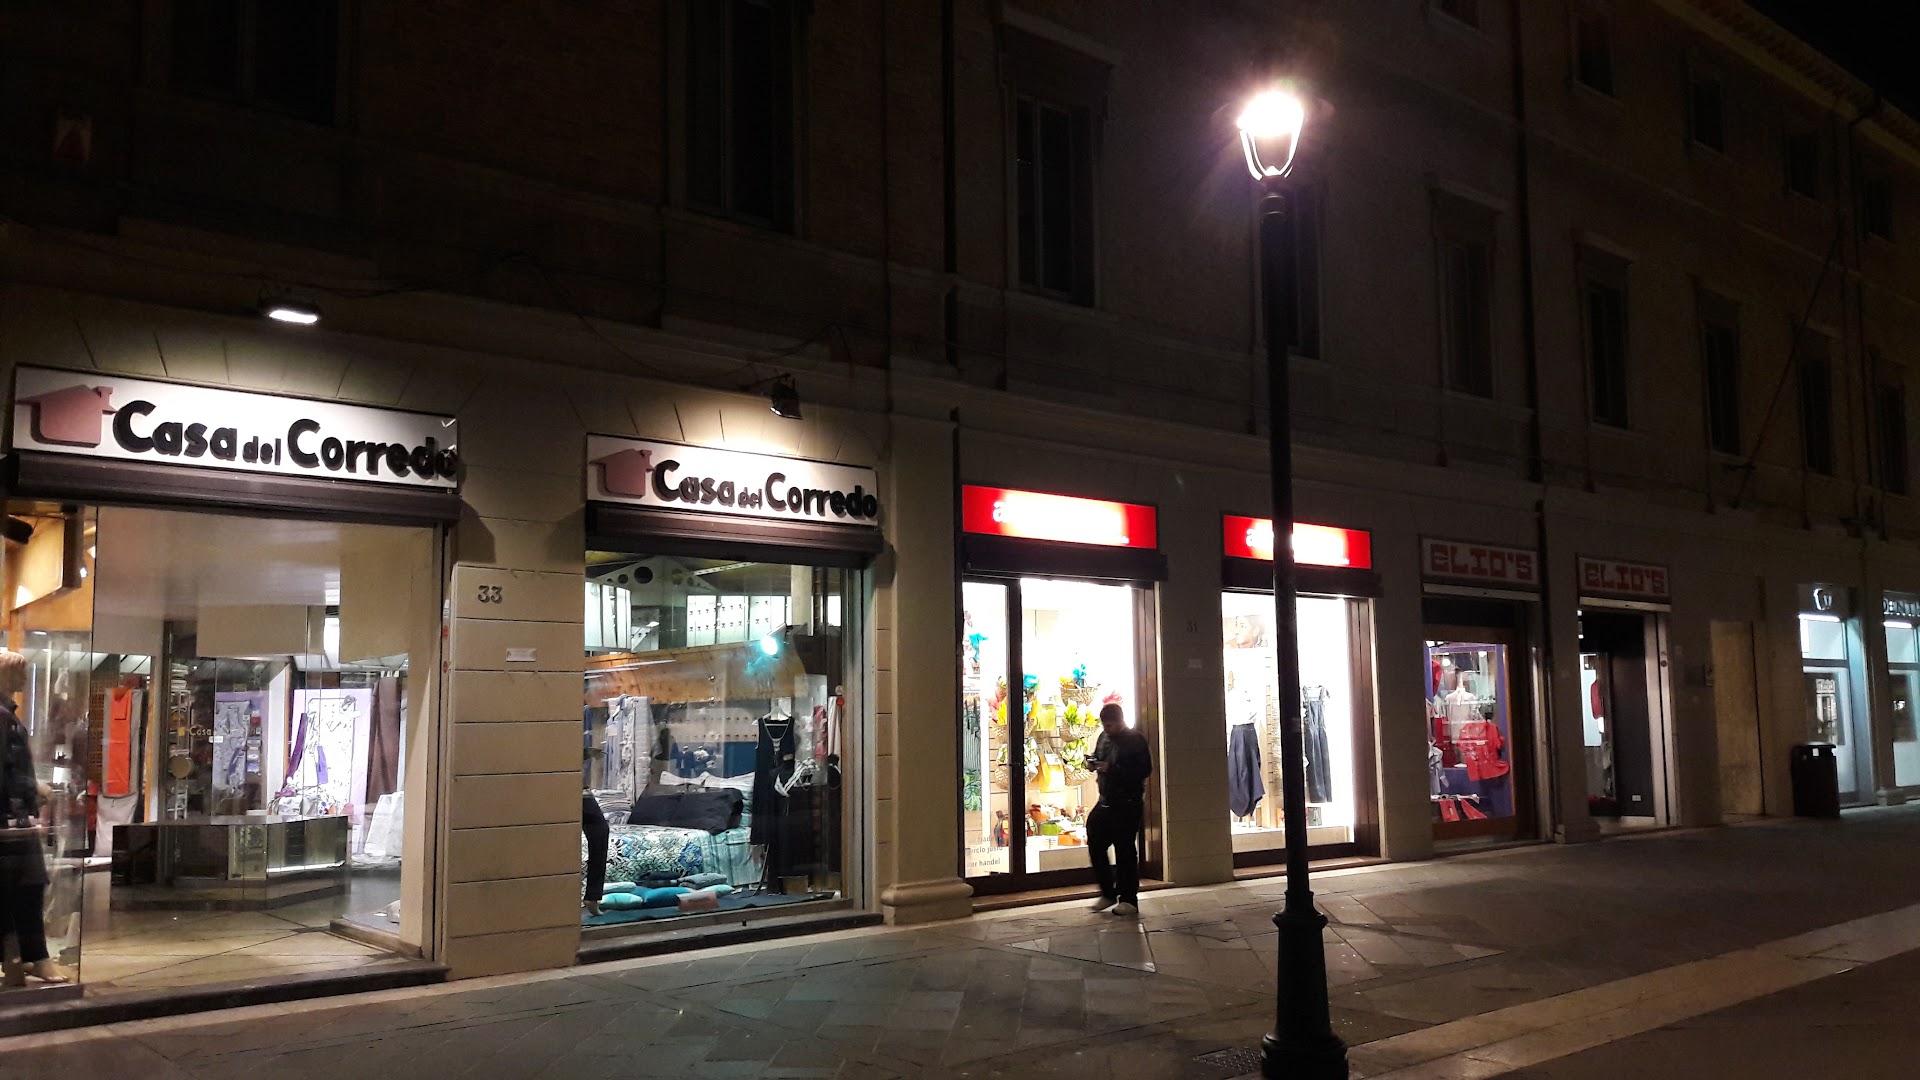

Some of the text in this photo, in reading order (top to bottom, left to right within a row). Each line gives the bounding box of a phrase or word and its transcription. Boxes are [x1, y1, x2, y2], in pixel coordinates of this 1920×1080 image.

[112, 399, 458, 479] Casa del Corredo
[652, 459, 878, 519] Casa del Corredo
[477, 585, 503, 604] 33
